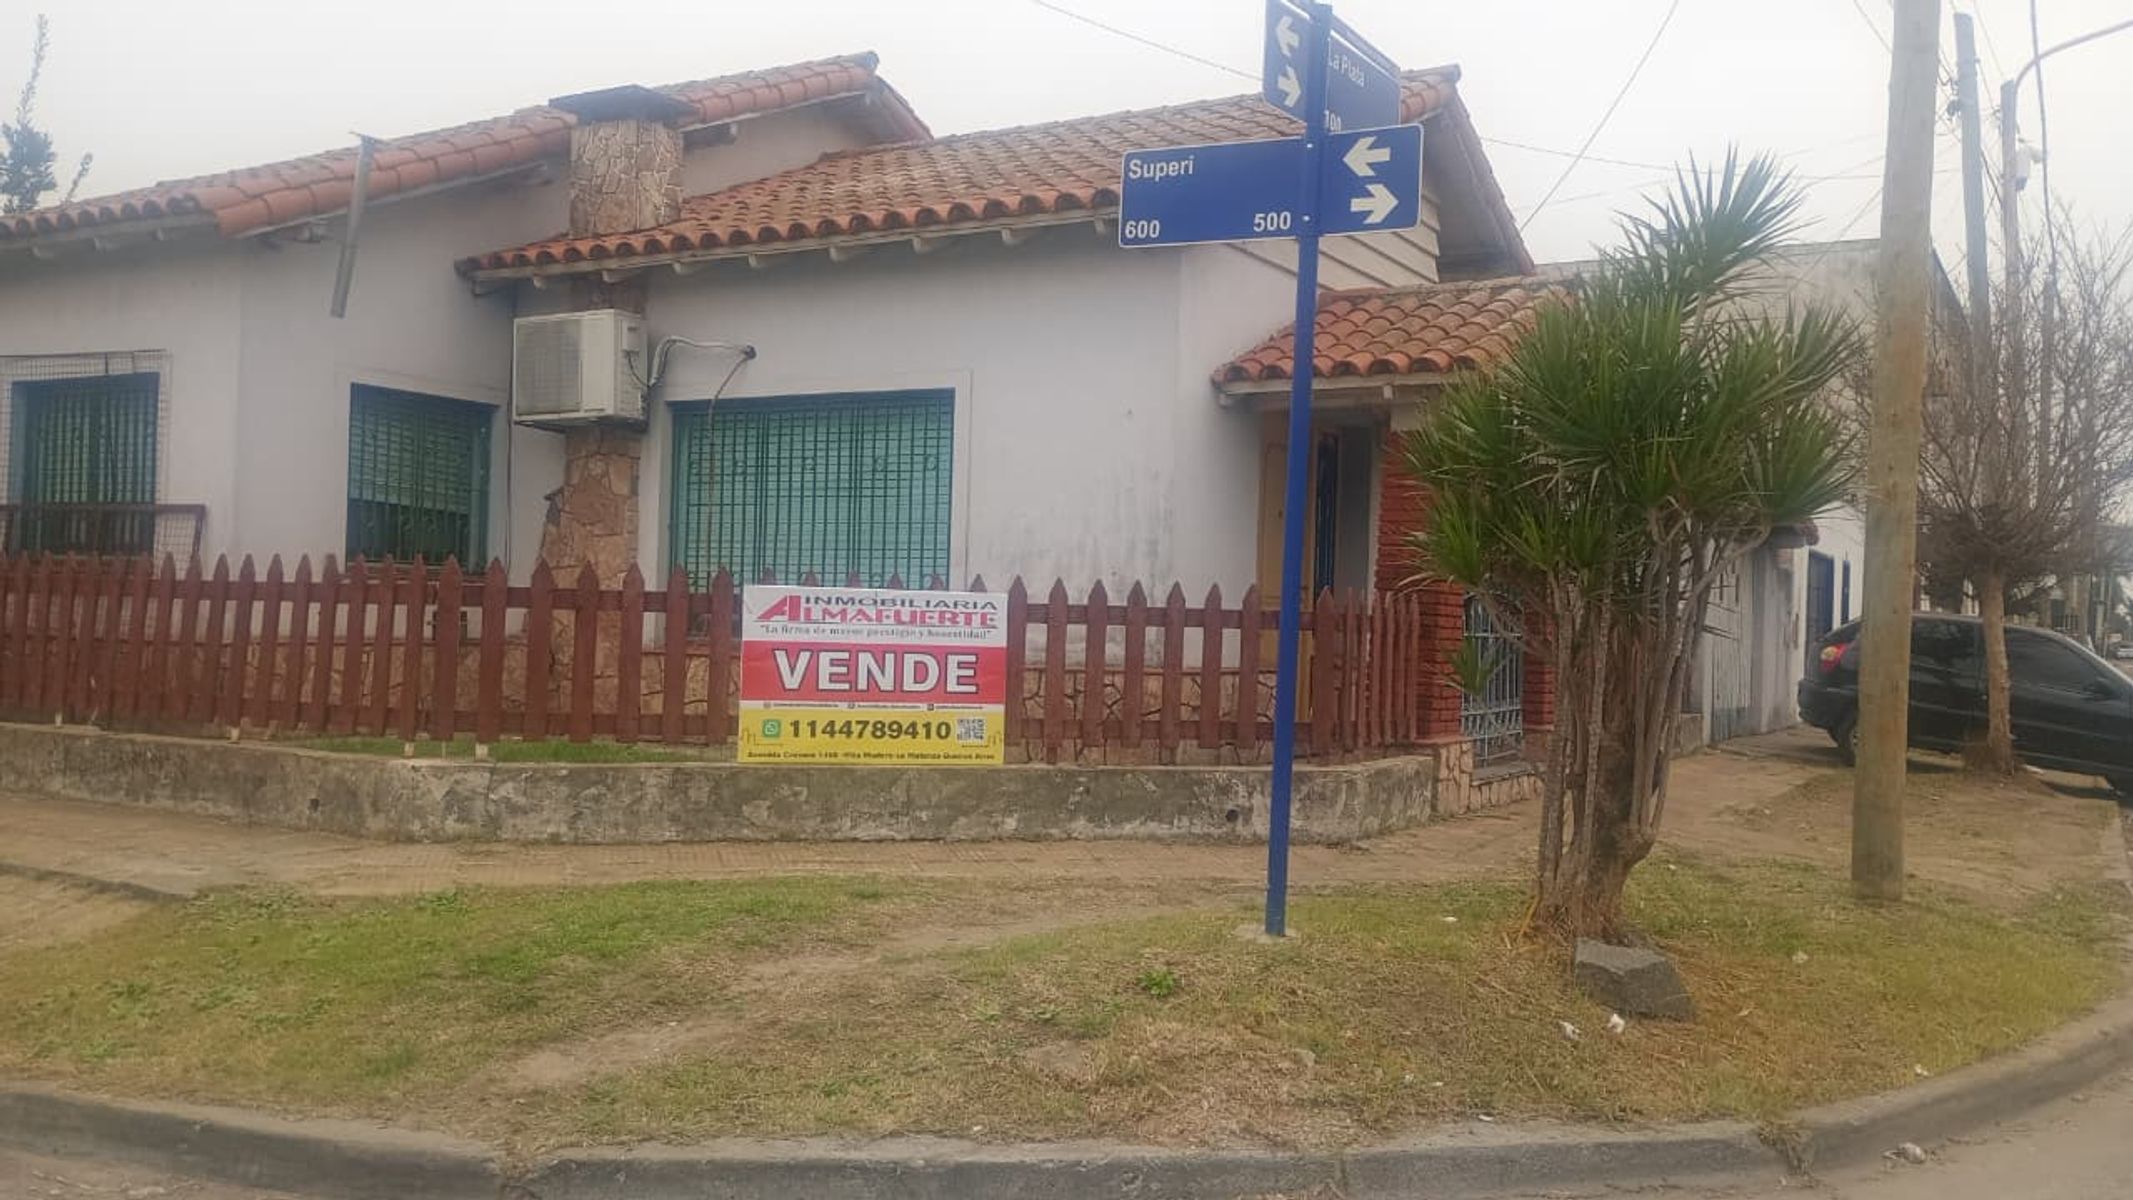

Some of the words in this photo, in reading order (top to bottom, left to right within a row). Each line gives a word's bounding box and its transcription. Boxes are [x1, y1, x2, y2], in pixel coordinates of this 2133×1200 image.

[1341, 53, 1365, 88] Plata
[1128, 155, 1195, 182] Superi
[1124, 219, 1160, 239] 600
[1253, 211, 1292, 232] 500
[756, 594, 997, 627] ALMAFUERTE
[804, 595, 998, 611] INMOBILIARIA
[773, 648, 980, 694] VENDE
[790, 719, 952, 740] 1144789410
